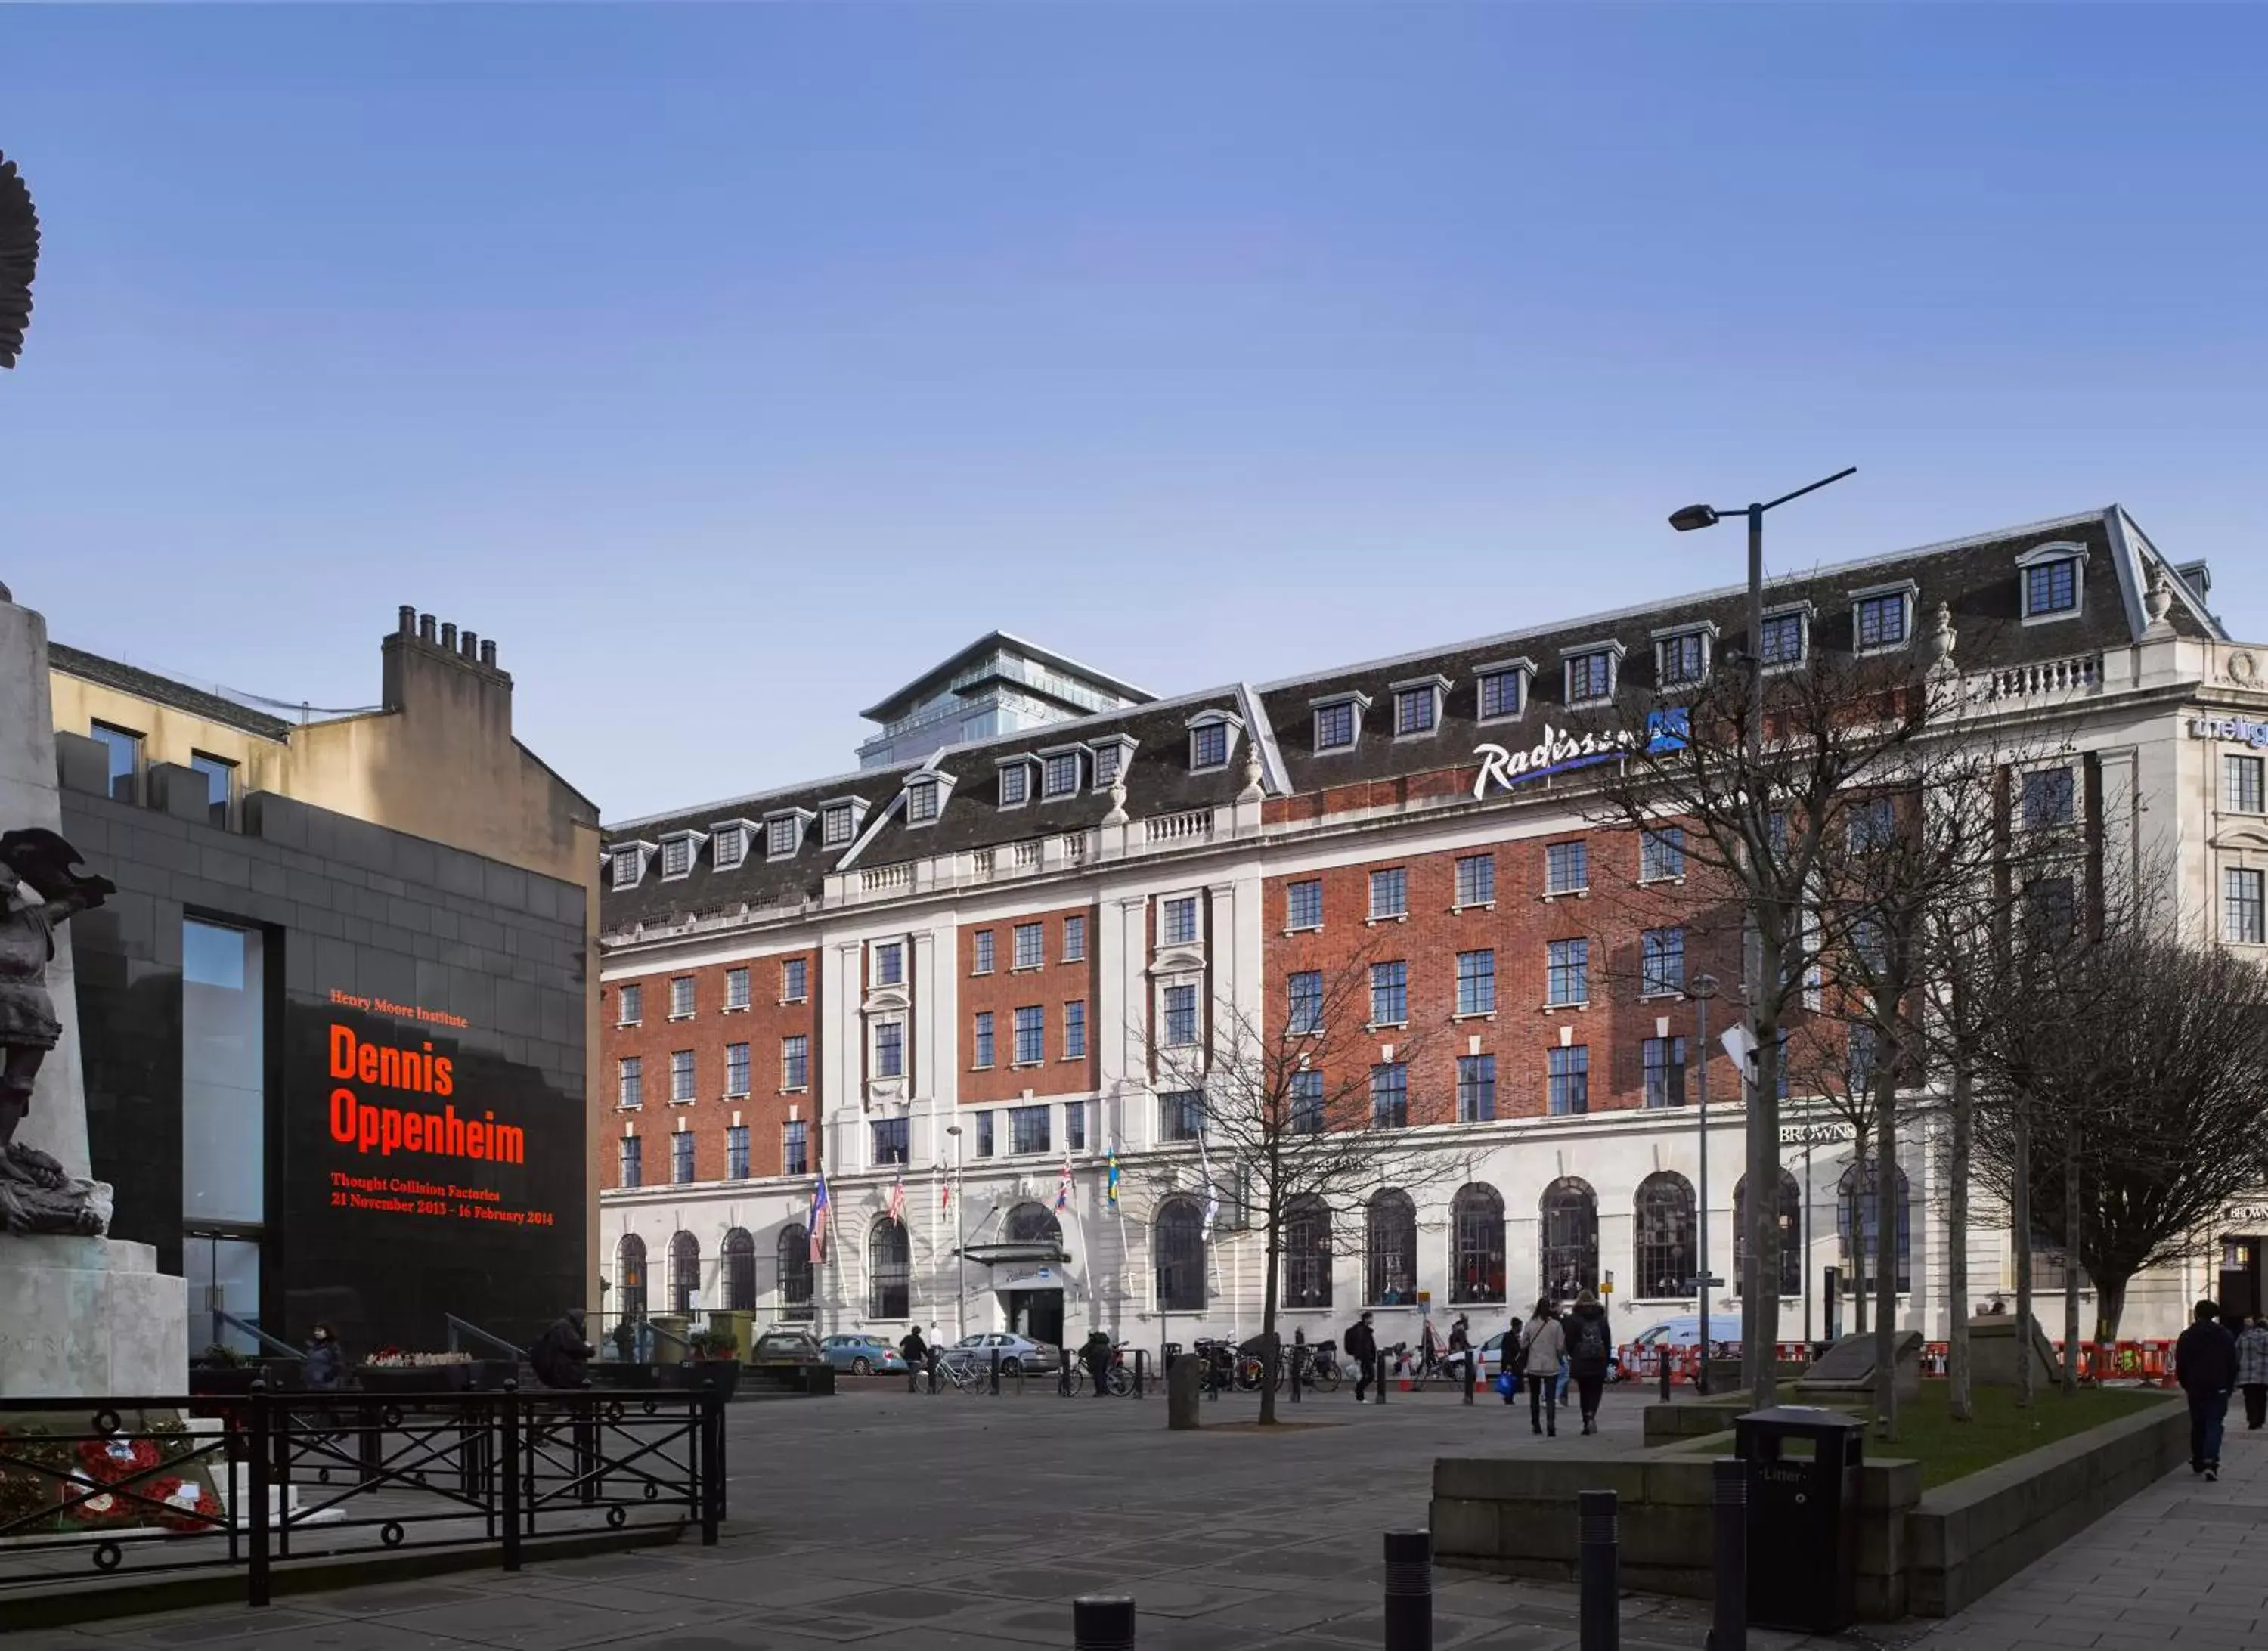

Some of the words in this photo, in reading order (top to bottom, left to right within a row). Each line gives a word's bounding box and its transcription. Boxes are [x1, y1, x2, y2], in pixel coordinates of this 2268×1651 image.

[330, 989, 371, 1011] Henry
[374, 998, 415, 1018] Moore
[417, 1007, 469, 1027] Institute
[330, 1024, 454, 1096] Dennis
[330, 1088, 524, 1164] Oppenheim
[1779, 1123, 1857, 1142] BROWNS
[330, 1172, 387, 1192] Thought
[389, 1179, 445, 1197] Collision
[448, 1185, 500, 1202] Factories
[331, 1193, 346, 1206] 21
[350, 1194, 415, 1213] November
[458, 1204, 471, 1218] 16
[473, 1206, 525, 1224] February
[527, 1212, 554, 1225] 2014
[1764, 1467, 1801, 1482] Litter
